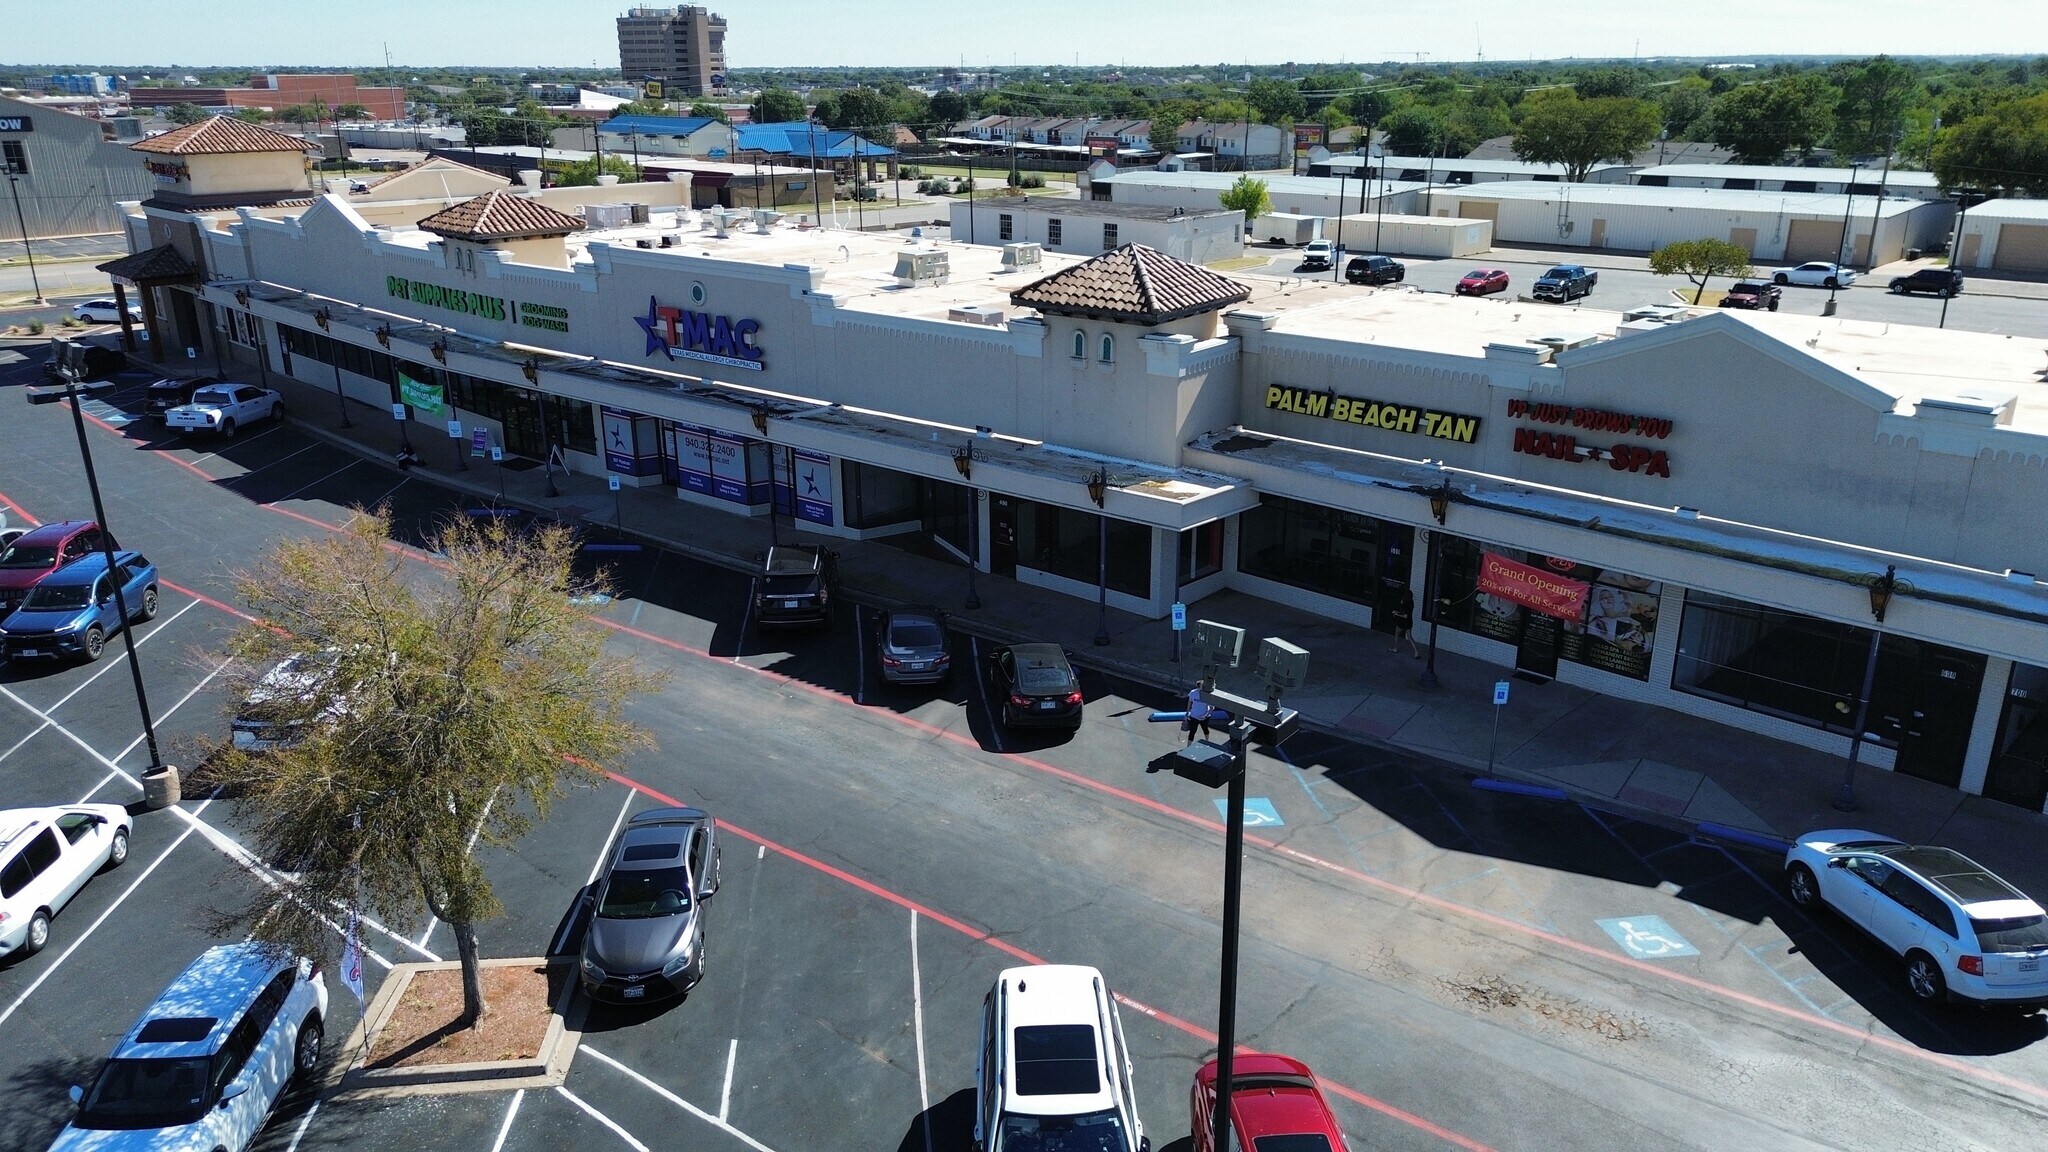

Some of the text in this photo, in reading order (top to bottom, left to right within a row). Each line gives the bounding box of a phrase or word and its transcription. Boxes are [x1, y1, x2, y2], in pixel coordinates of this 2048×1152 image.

[386, 275, 506, 321] PET SUPPLIES PLUS
[520, 302, 569, 319] GROOMING
[522, 316, 569, 332] DOG WASH
[657, 306, 763, 360] TMAC
[671, 349, 761, 369] TEXAS MEDICAL ALLERGY CHIROPRACTIC
[1265, 386, 1476, 443] PALM BEACH TAN
[1508, 399, 1673, 439] VP JUST BROWS YOU
[685, 437, 735, 457] 940.322.2400
[1513, 428, 1671, 478] NAIL SPA
[1482, 578, 1497, 589] 20%
[1498, 585, 1512, 595] off
[1513, 590, 1527, 600] For
[1528, 595, 1541, 605] All
[1542, 599, 1576, 618] Services
[1489, 561, 1579, 602] Grand Opening
[2011, 687, 2028, 698] 700
